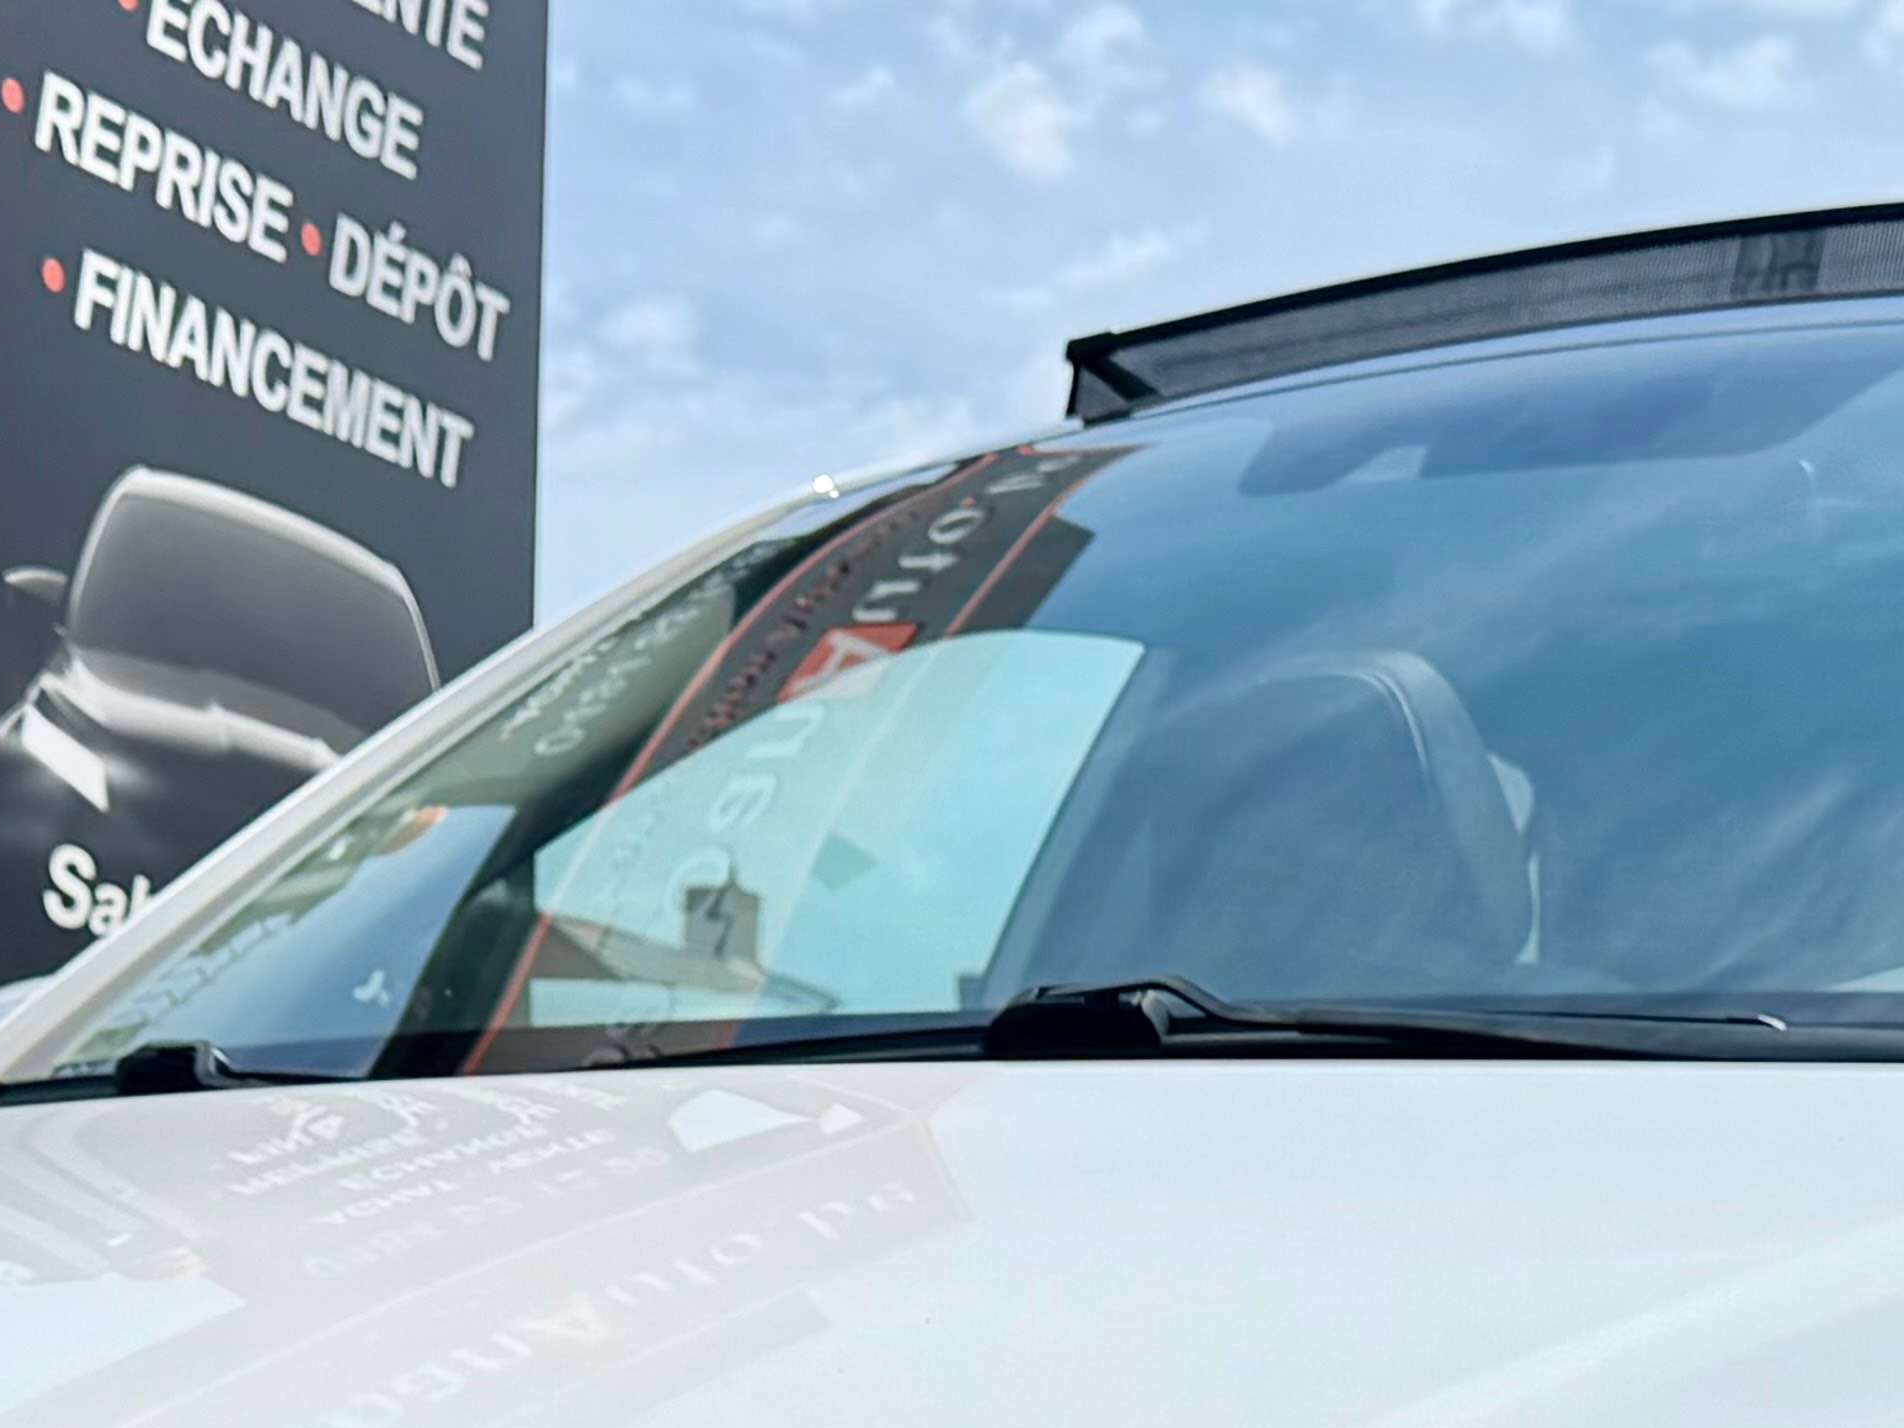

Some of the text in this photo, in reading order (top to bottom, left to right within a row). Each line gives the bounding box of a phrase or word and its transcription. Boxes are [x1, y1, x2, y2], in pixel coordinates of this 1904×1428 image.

[35, 70, 510, 362] REPRISE DÉPÔT
[74, 247, 475, 488] FINANCEMENT
